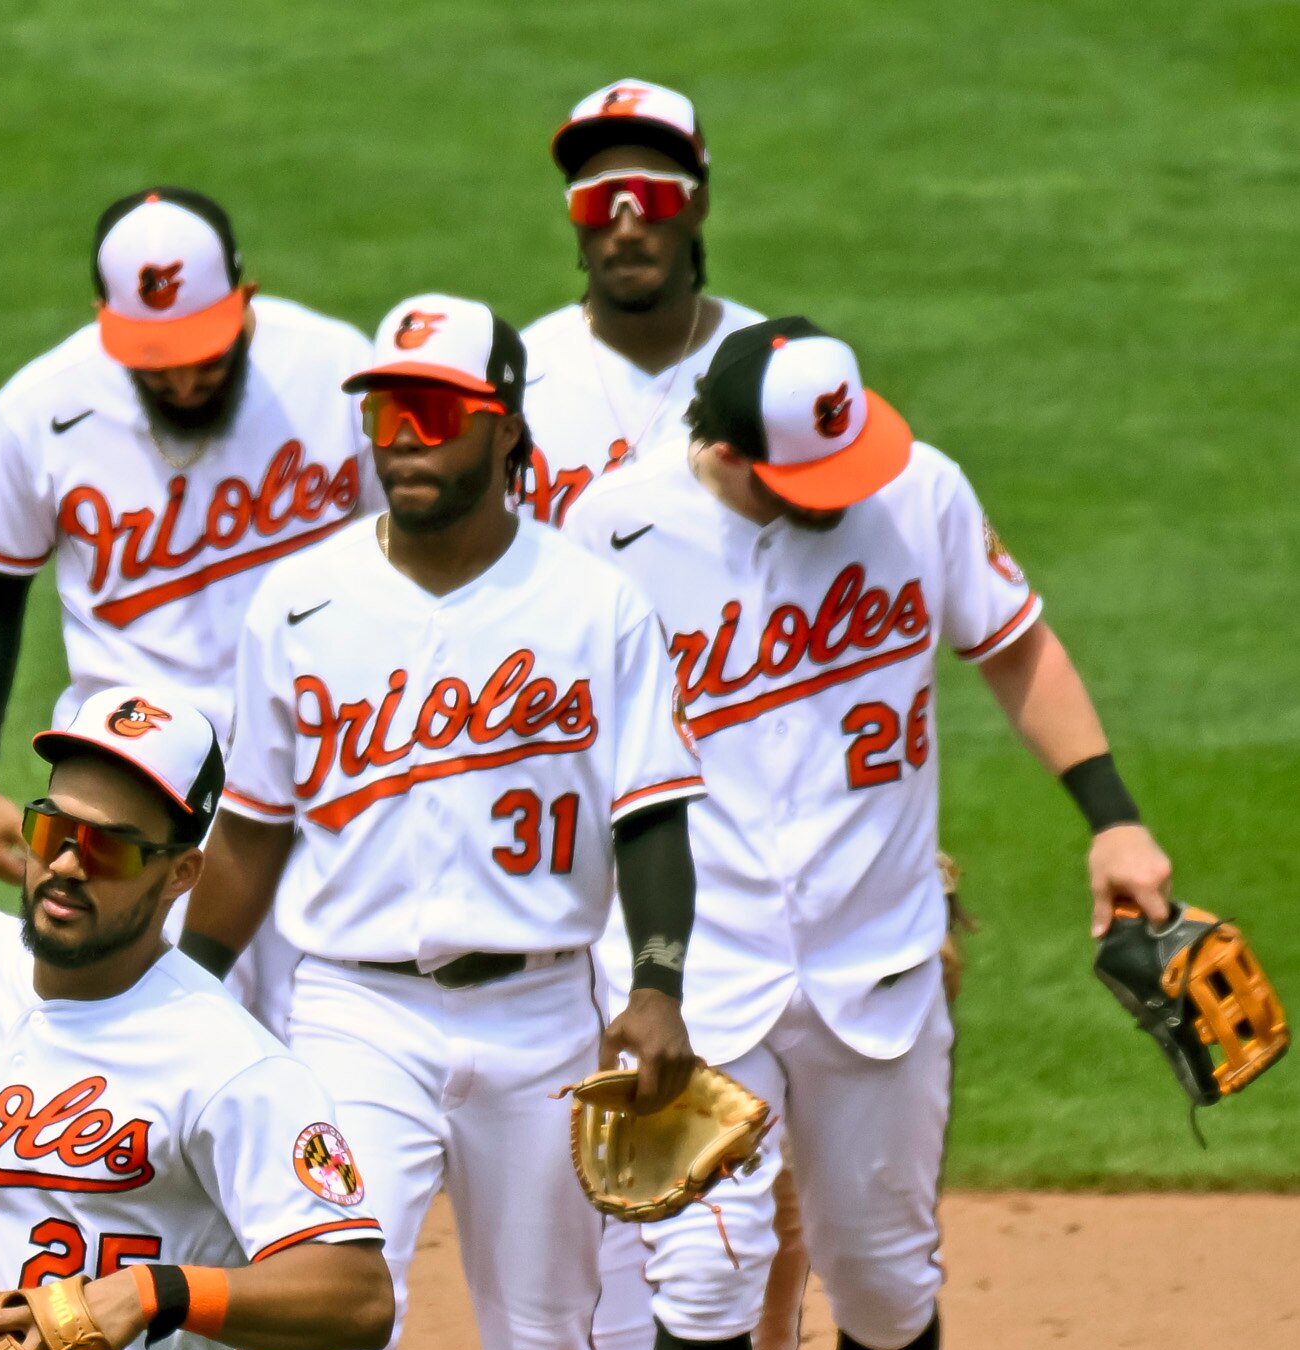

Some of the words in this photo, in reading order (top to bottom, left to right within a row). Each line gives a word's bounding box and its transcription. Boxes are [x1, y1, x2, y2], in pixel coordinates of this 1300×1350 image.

[57, 438, 361, 595] Orioles
[668, 562, 931, 706] rioles
[293, 647, 599, 801] Orioles
[490, 788, 581, 876] 31
